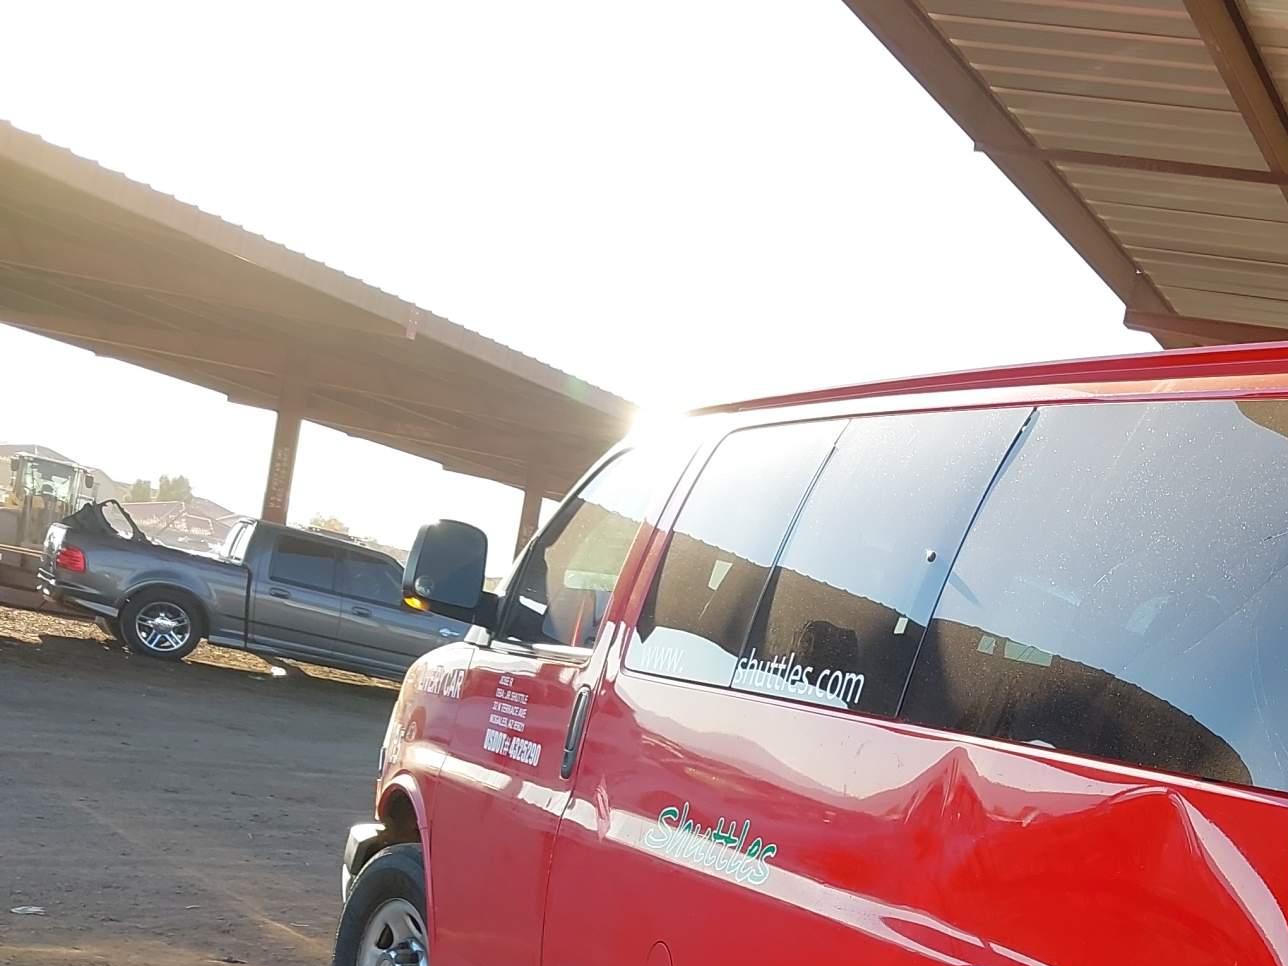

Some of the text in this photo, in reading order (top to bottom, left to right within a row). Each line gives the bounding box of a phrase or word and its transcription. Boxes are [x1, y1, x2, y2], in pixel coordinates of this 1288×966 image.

[640, 645, 865, 704] www. shuttles.com
[644, 801, 778, 886] Shuttles
